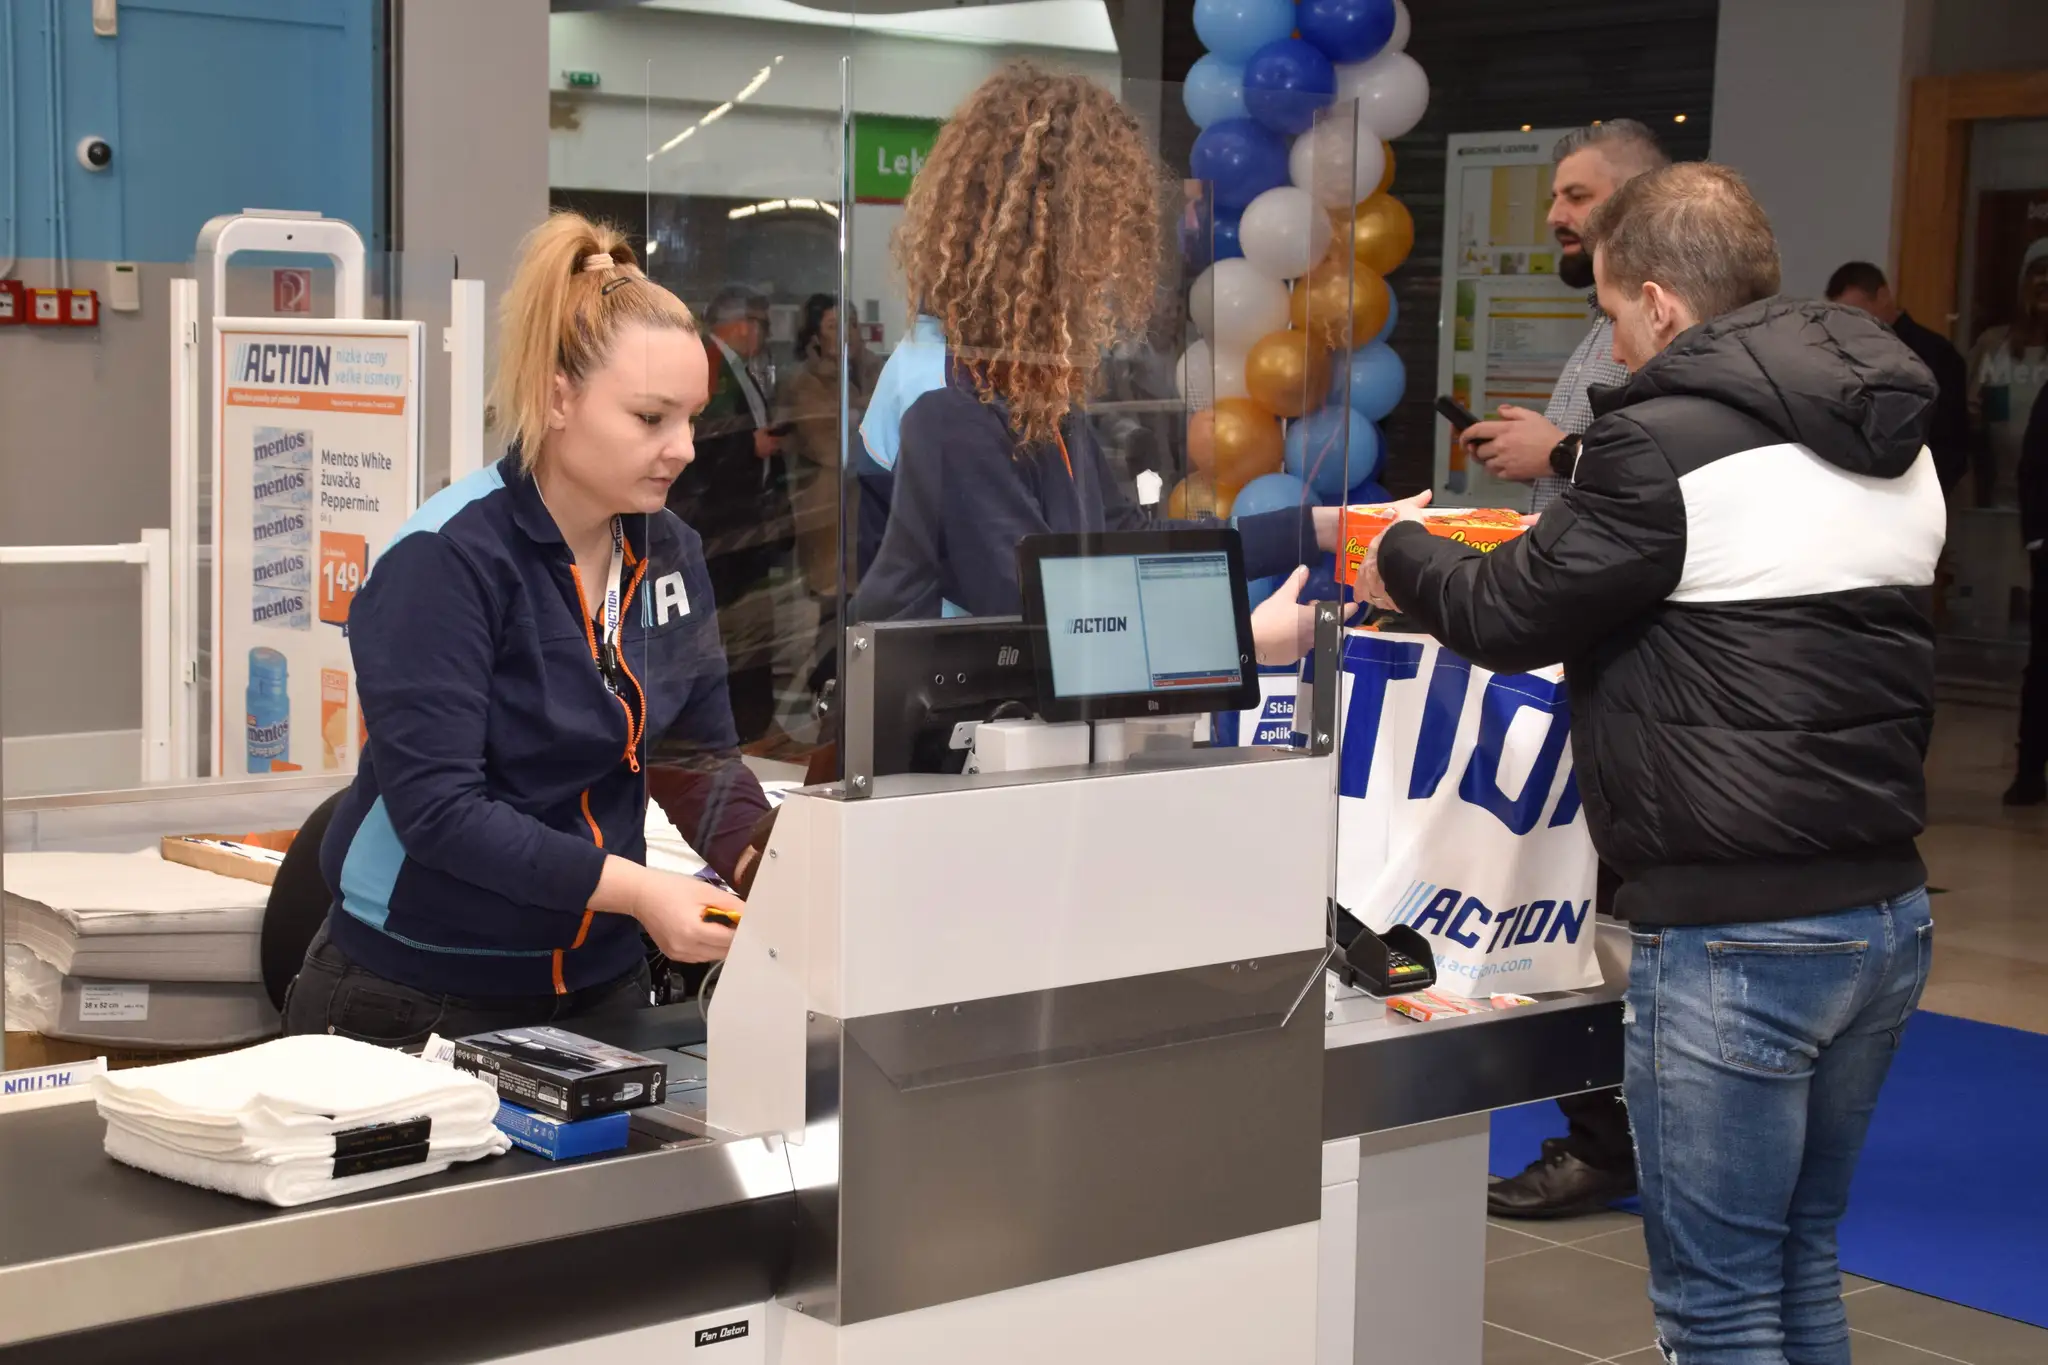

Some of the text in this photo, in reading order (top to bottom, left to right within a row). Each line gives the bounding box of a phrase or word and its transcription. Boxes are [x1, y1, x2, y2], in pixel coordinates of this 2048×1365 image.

[243, 343, 332, 386] ACTION
[253, 431, 305, 462] mentos
[321, 449, 392, 470] Mentos White
[253, 472, 305, 500] mentos
[321, 469, 361, 489] žuvačka
[321, 491, 380, 513] Peppermint
[253, 513, 305, 541] mentos
[253, 554, 305, 582] mentos
[253, 595, 304, 622] mentos
[607, 590, 618, 630] ACTION
[655, 570, 691, 626] A
[1072, 616, 1127, 634] ACTION
[1269, 702, 1294, 714] Stia
[1260, 727, 1291, 742] aplik
[1301, 634, 1583, 836] TIO
[1411, 888, 1592, 954] ACTION
[700, 1326, 746, 1342] Pan Oston
